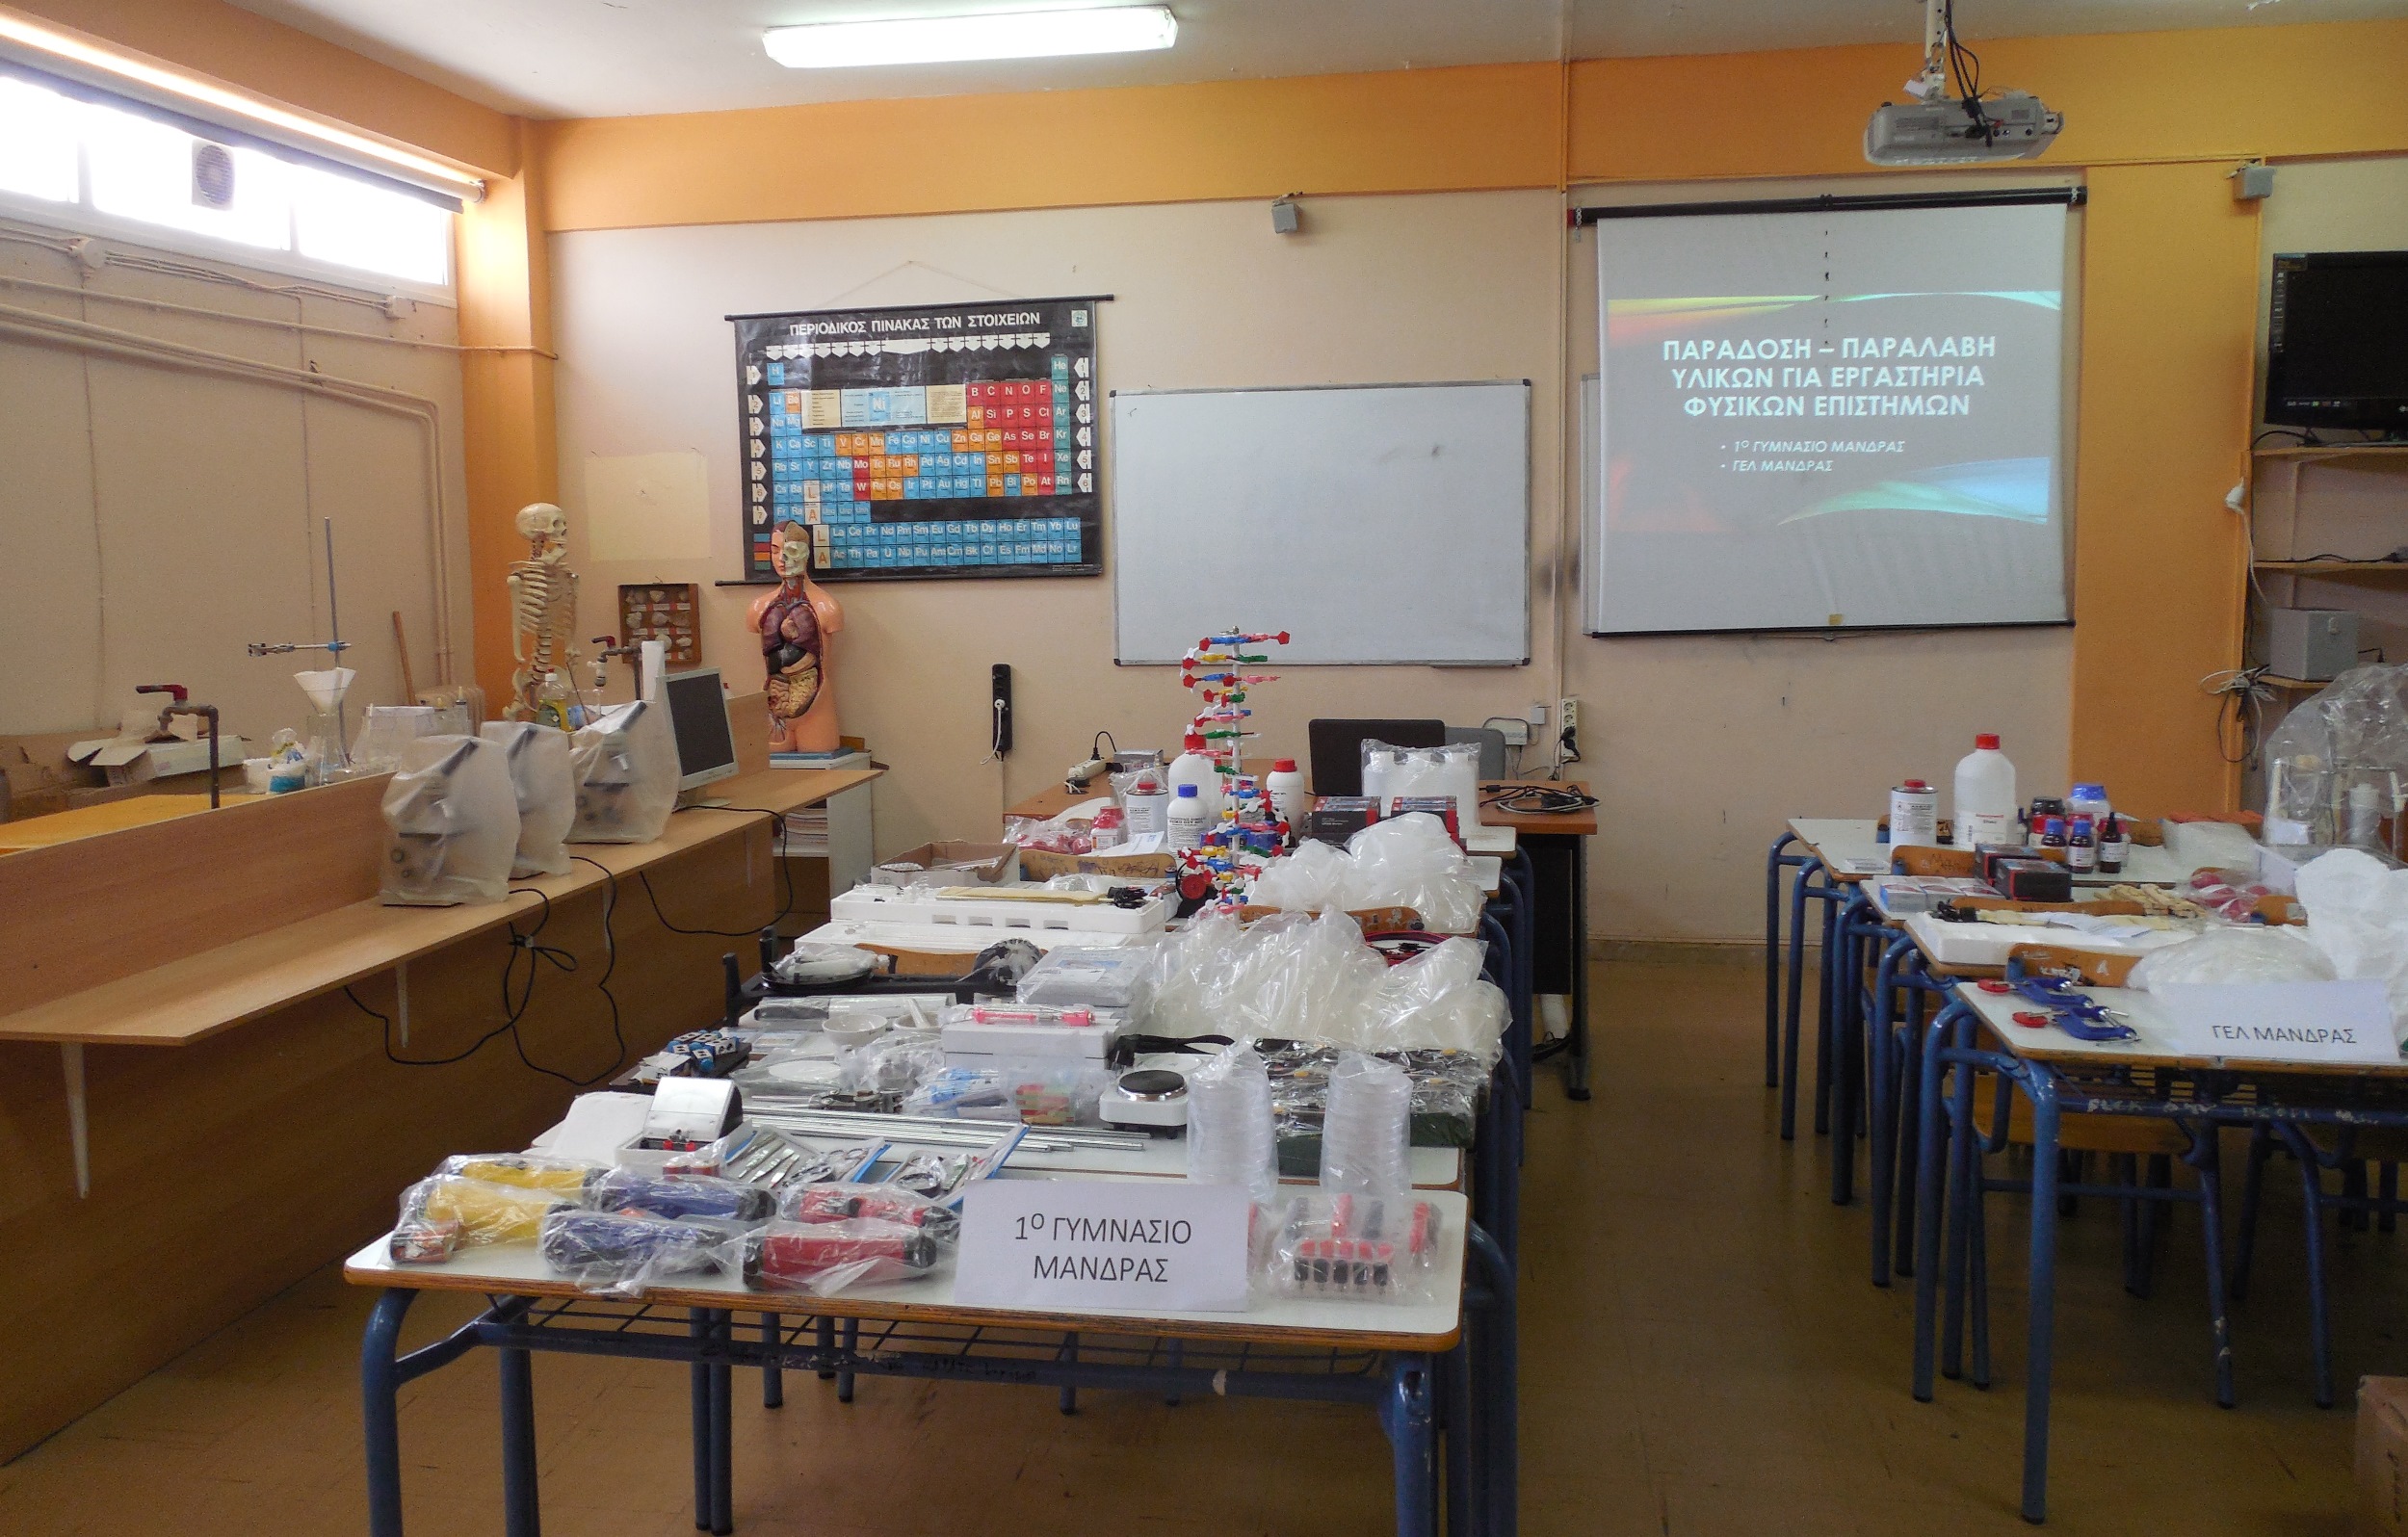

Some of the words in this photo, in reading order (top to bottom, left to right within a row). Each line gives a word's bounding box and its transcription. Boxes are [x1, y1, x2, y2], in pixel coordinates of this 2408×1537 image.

[790, 321, 866, 336] ΠΕΡΙΟΔΙΚΟΣ
[871, 318, 929, 332] ΠΙΝΑΚΑΣ
[934, 316, 962, 329] ΤΩΝ
[967, 312, 1041, 327] ΣΤΟΙΧΕΙΩΝ
[1663, 339, 1811, 360] ΠΑΡΑΔΟΣΗ
[1843, 336, 1996, 358] ΠΑΡΑΛΑΒΗ
[1054, 360, 1067, 369] He
[1671, 367, 1773, 388] ΥΛΙΚΩΝ
[1783, 367, 1822, 387] ΓΙΑ
[1831, 365, 1985, 387] ΕΡΓΑΣΤΗΡΙΑ
[971, 387, 978, 396] B
[987, 385, 995, 395] C
[1005, 386, 1012, 395] N
[1022, 384, 1030, 394] O
[1039, 384, 1046, 393] F
[971, 410, 981, 419] Al
[986, 409, 996, 418] Si
[1006, 408, 1013, 417] P
[1023, 407, 1030, 417] S
[1038, 407, 1049, 416] Cl
[1056, 406, 1065, 415] Ar
[1684, 396, 1805, 416] ΦΥΣΙΚΩΝ
[1814, 395, 1970, 416] ΕΠΙΣΤΗΜΩΝ
[775, 440, 783, 449] K
[788, 438, 800, 448] Ca
[803, 438, 816, 448] Sc
[822, 438, 831, 447] Ti
[840, 437, 847, 446] V
[854, 437, 865, 446] Cr
[870, 437, 884, 446] Mn
[888, 435, 899, 444] Fe
[902, 435, 916, 444] Co
[919, 434, 929, 443] Ni
[936, 433, 950, 443] Cu
[954, 433, 966, 442] Zn
[970, 432, 982, 441] Ga
[986, 431, 1000, 441] Ge
[1003, 431, 1016, 440] As
[1021, 430, 1034, 439] Se
[1039, 430, 1050, 439] Br
[1056, 430, 1066, 438] Kr
[1752, 441, 1827, 452] ΓΥΜΝΑΣΙΟ
[1831, 441, 1905, 453] ΜΑΝΔΡΑΣ
[790, 461, 799, 470] Sr
[806, 460, 813, 469] Y
[823, 460, 833, 469] Zr
[837, 459, 851, 468] Nb
[853, 459, 868, 468] Mo
[873, 459, 883, 468] Tc
[887, 457, 901, 467] Ru
[904, 458, 917, 467] Rh
[921, 457, 933, 466] Pd
[937, 456, 950, 466] Ag
[954, 456, 967, 465] Cd
[974, 455, 982, 464] In
[987, 456, 1000, 464] Sn
[1005, 454, 1017, 463] Sb
[1022, 454, 1034, 462] Te
[1057, 453, 1068, 461] Xe
[1733, 460, 1757, 471] ΓΕΛ
[1761, 460, 1833, 471] ΜΑΝΔΡΑΣ
[774, 484, 786, 493] Cs
[808, 487, 816, 499] L
[823, 482, 833, 491] Hf
[840, 482, 852, 491] Ta
[855, 482, 868, 490] W
[888, 481, 902, 489] Os
[907, 480, 914, 489] Ir
[921, 480, 932, 488] Pt
[937, 479, 950, 487] Au
[955, 477, 968, 488] Hg
[971, 478, 982, 486] Tl
[989, 478, 1003, 486] Pb
[1008, 477, 1016, 485] Bi
[1023, 477, 1035, 485] Po
[1040, 476, 1051, 484] At
[776, 507, 786, 515] Fr
[809, 509, 817, 521] A
[817, 530, 825, 542] L
[848, 526, 861, 535] Ce
[866, 526, 877, 534] Pr
[881, 526, 894, 534] Nd
[913, 525, 929, 534] Sm
[931, 525, 944, 534] Eu
[947, 524, 960, 533] Gd
[982, 523, 994, 533] Dy
[999, 522, 1012, 532] Ho
[1016, 522, 1027, 531] Er
[1031, 521, 1046, 531] Tm
[1049, 521, 1061, 530] Yb
[1066, 521, 1078, 530] Lu
[819, 554, 827, 563] A
[850, 549, 861, 558] Th
[883, 548, 892, 557] U
[916, 548, 928, 557] Pu
[947, 546, 962, 555] Cm
[964, 546, 978, 555] Bk
[982, 544, 994, 555] Cf
[1000, 545, 1011, 554] Es
[1015, 544, 1030, 553] Fm
[1049, 544, 1062, 553] No
[1067, 543, 1077, 552] Lr
[2212, 1025, 2250, 1040] ΓΕΛ
[2254, 1027, 2357, 1044] ΜΑΝΔΡΑΣ
[1053, 1217, 1191, 1244] ΓΥΜΝΑΣΙΟ
[1034, 1256, 1168, 1282] ΜΑΝΔΡΑΣ
